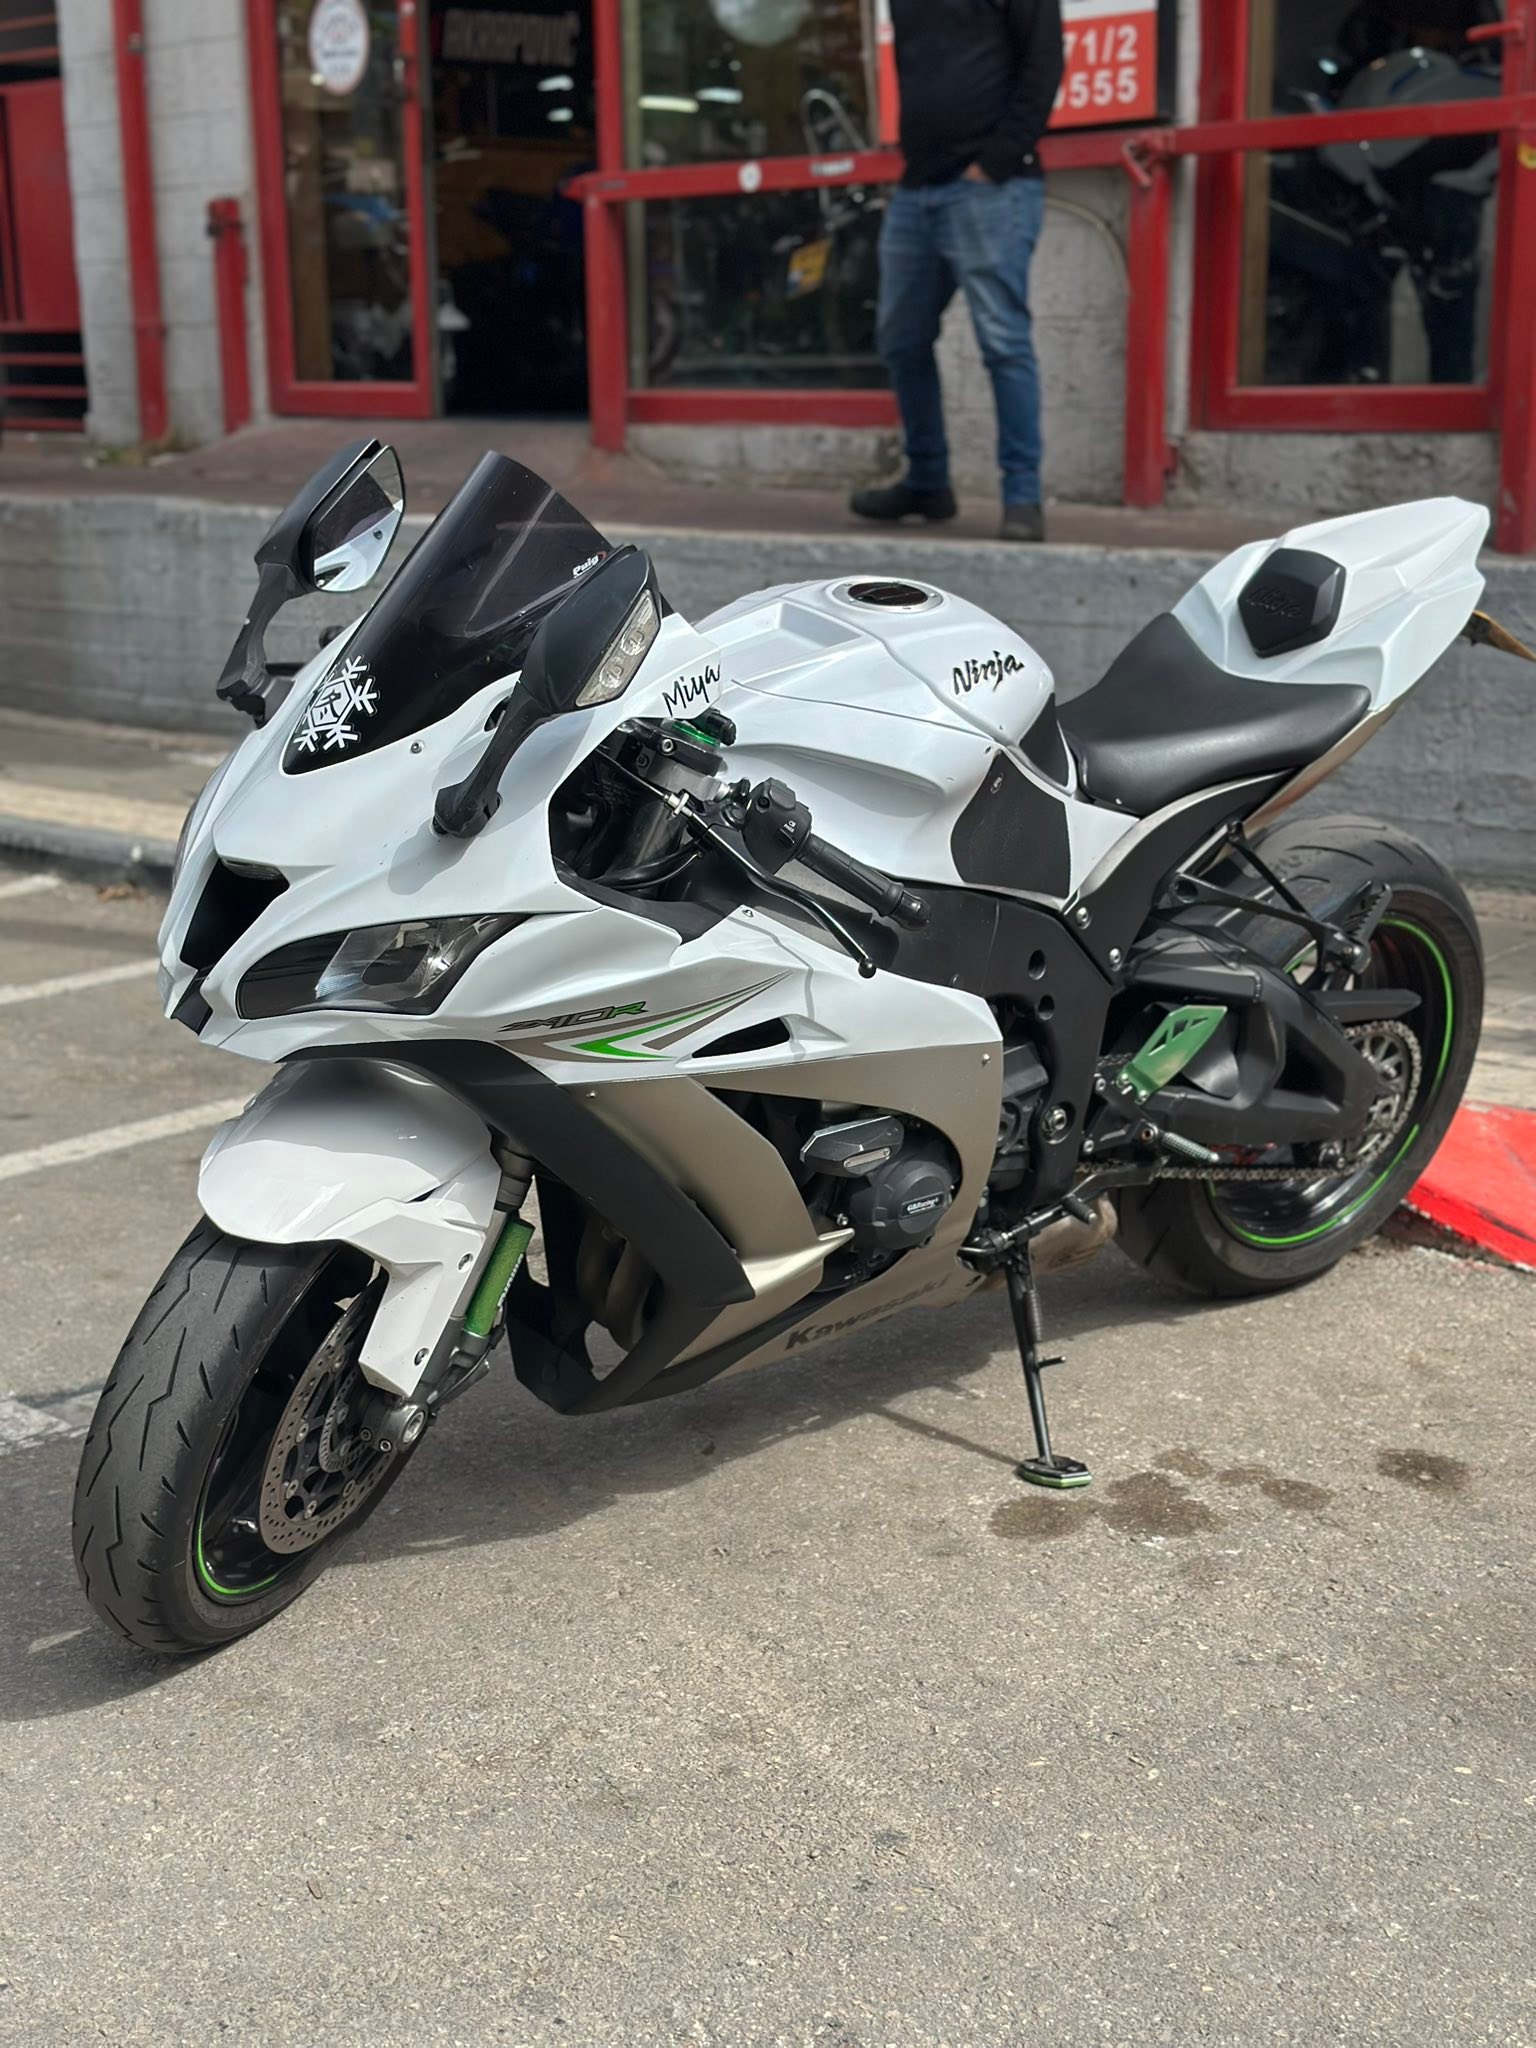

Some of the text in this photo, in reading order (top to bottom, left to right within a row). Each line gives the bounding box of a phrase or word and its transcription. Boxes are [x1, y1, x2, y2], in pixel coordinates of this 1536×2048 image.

[572, 554, 599, 578] Puig
[661, 664, 720, 716] Miya
[952, 650, 1025, 694] Ninja
[784, 1272, 953, 1350] Kawasaki
